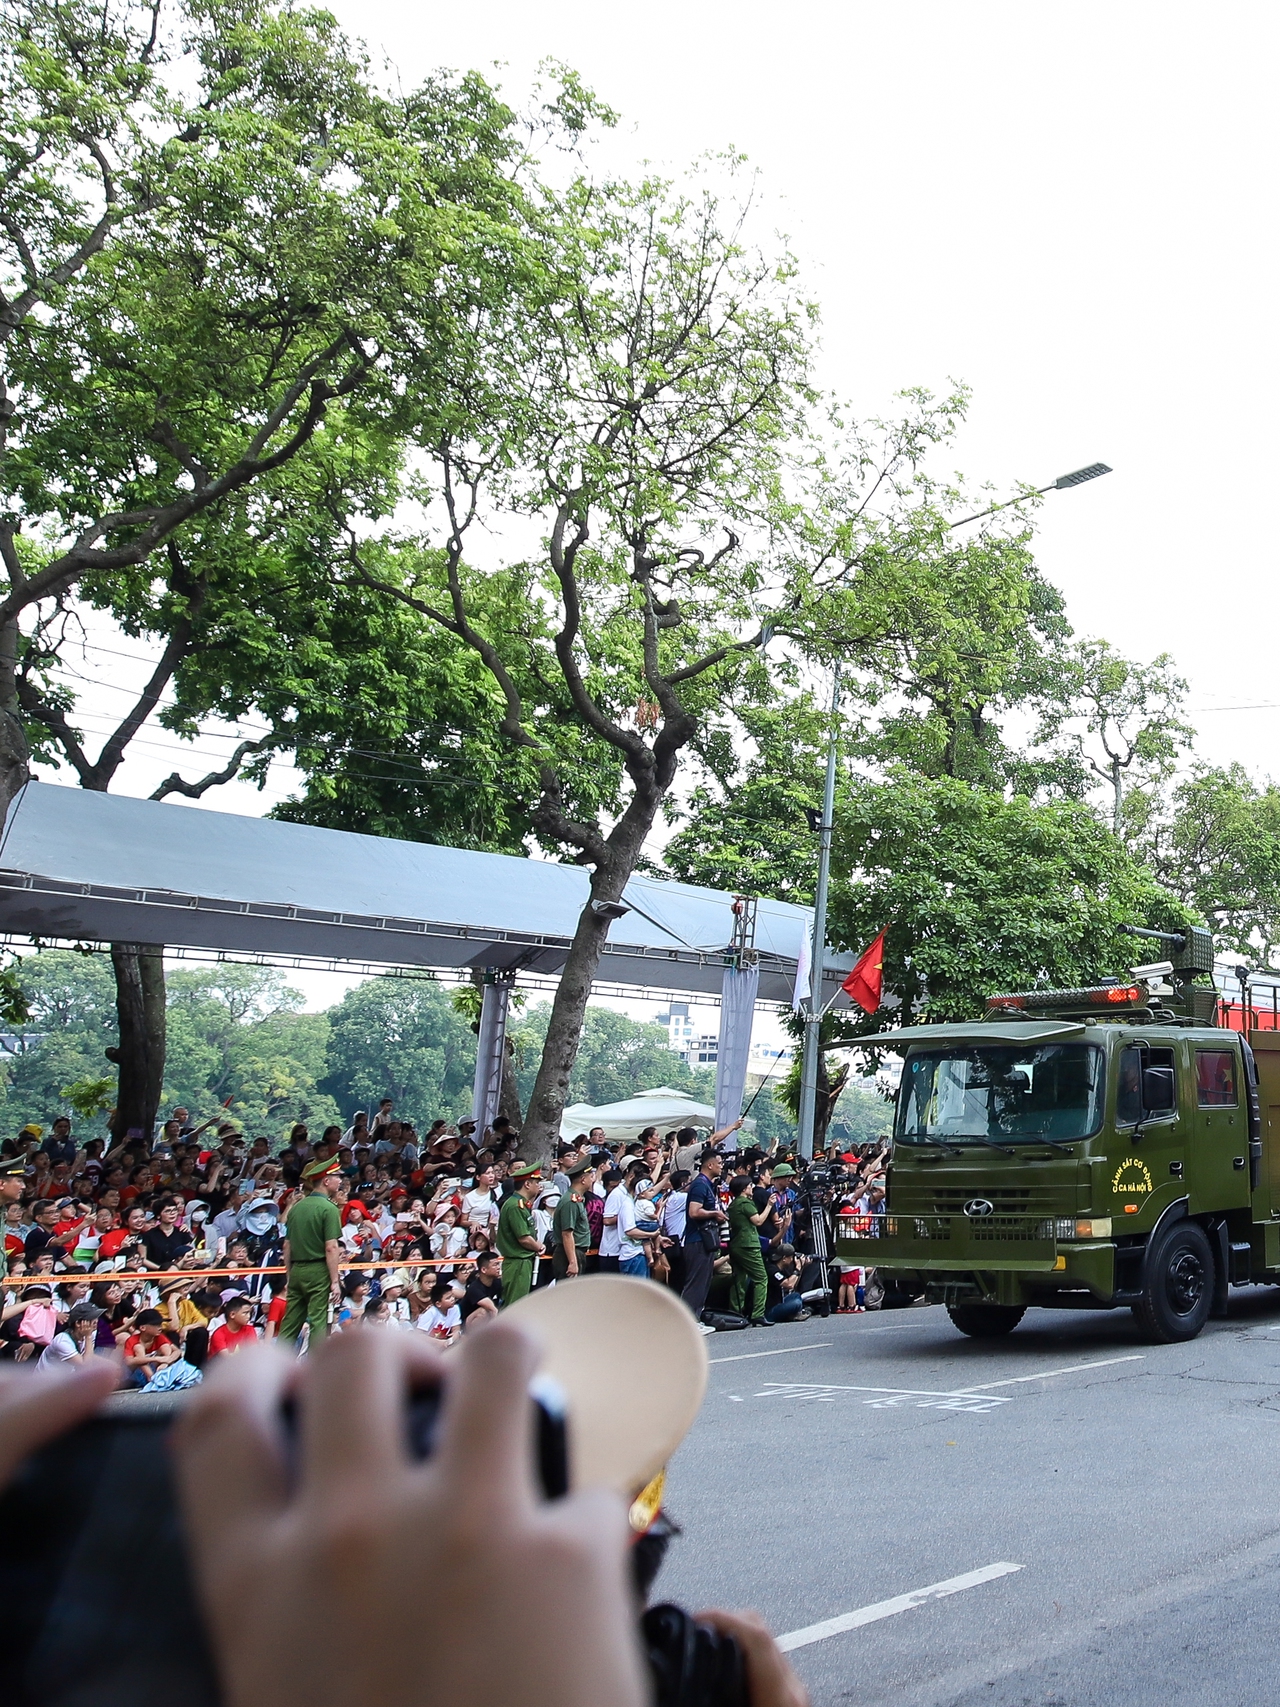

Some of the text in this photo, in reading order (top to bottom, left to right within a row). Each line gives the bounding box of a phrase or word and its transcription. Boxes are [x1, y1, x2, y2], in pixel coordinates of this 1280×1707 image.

[1111, 1166, 1123, 1193] CẢNH
[1122, 1157, 1133, 1170] SÁT
[1133, 1158, 1143, 1169] CƠ
[1118, 1182, 1147, 1194] CA HÀ NỘI
